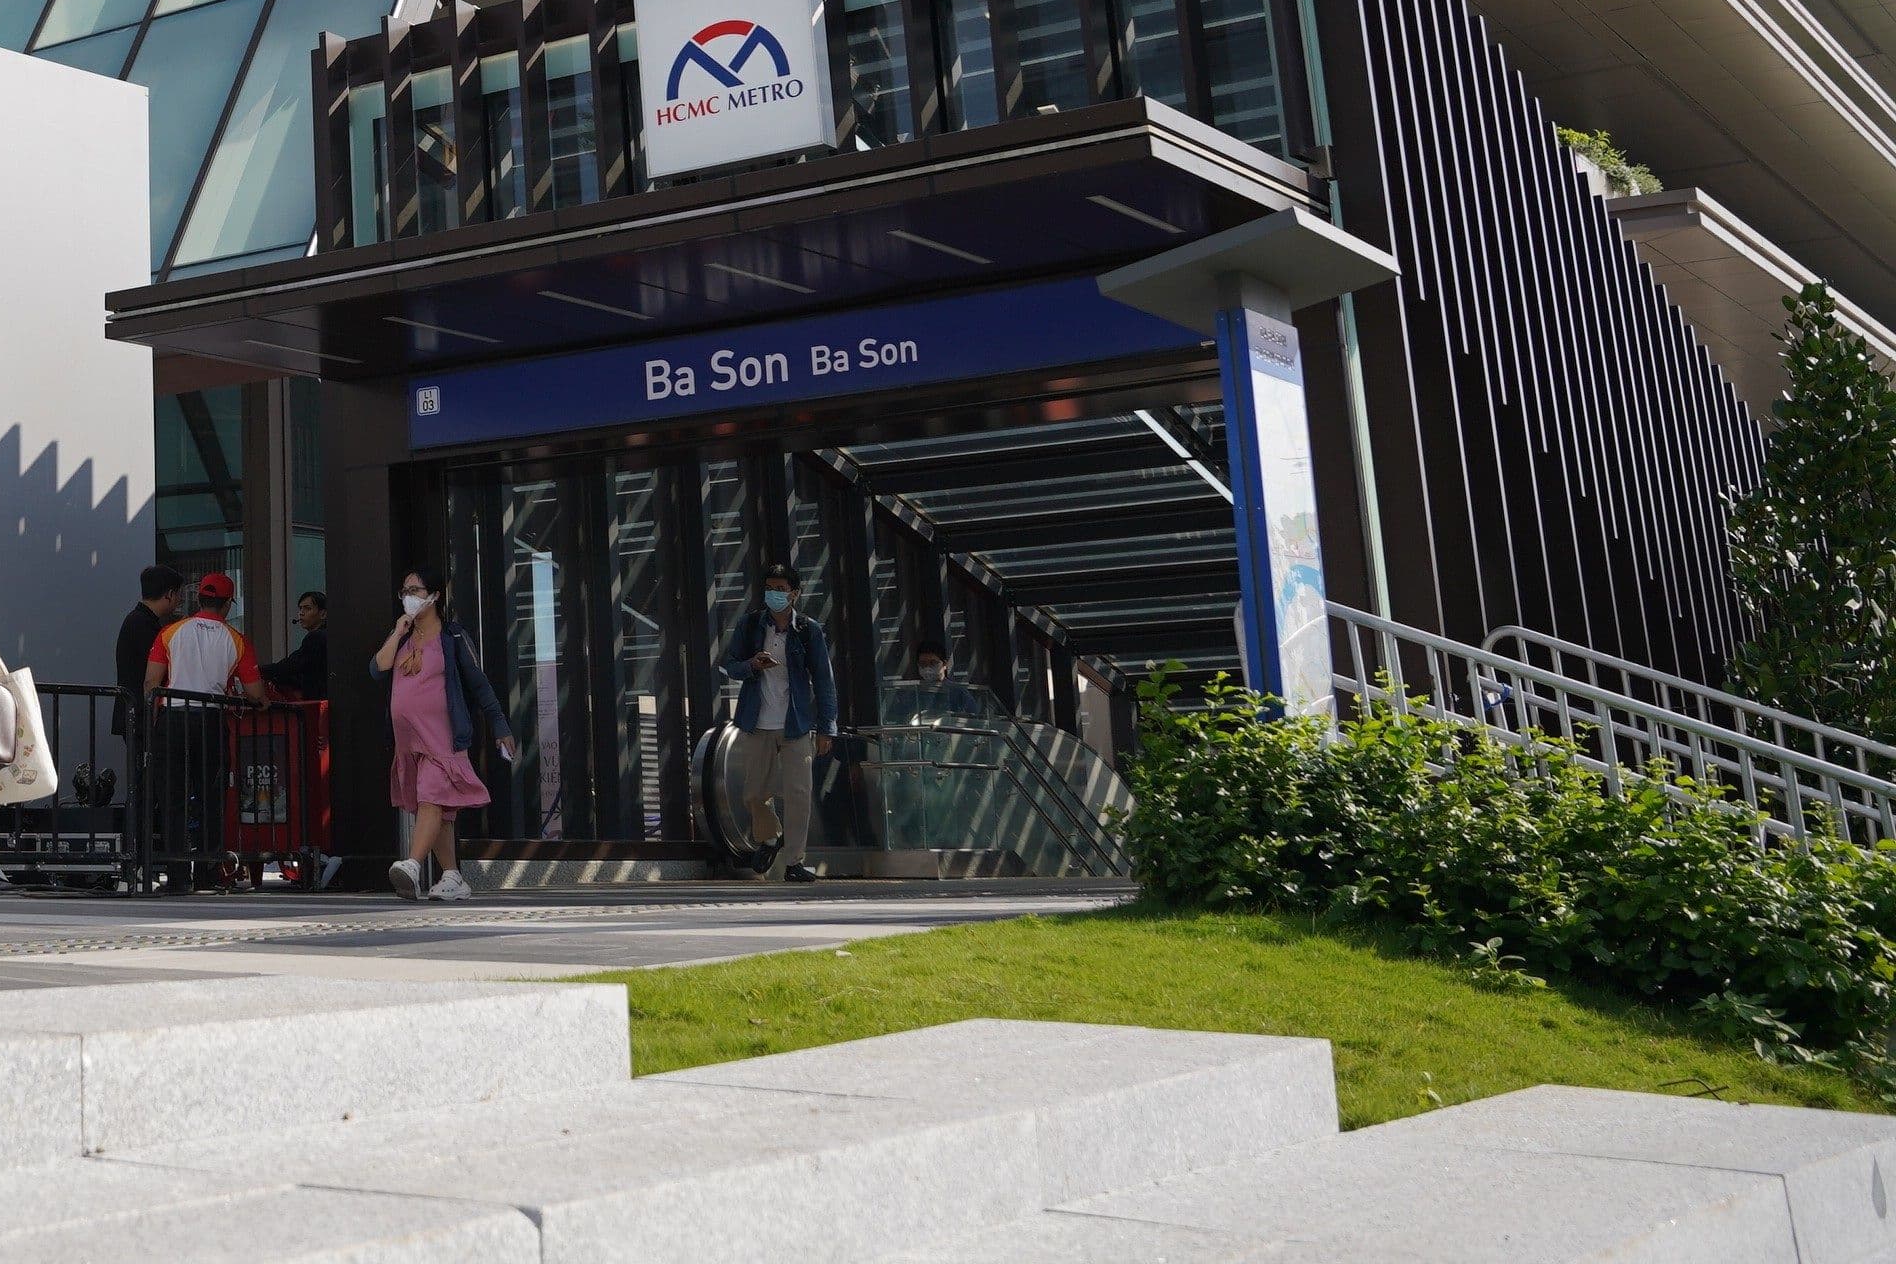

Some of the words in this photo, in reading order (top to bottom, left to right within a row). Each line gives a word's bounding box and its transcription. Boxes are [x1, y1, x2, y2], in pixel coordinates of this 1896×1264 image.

[657, 95, 720, 126] HCMC
[728, 78, 804, 111] METRO
[645, 359, 696, 401] Ba
[710, 349, 789, 391] Son
[810, 345, 850, 376] Ba
[858, 338, 918, 369] Son
[422, 399, 435, 412] 03
